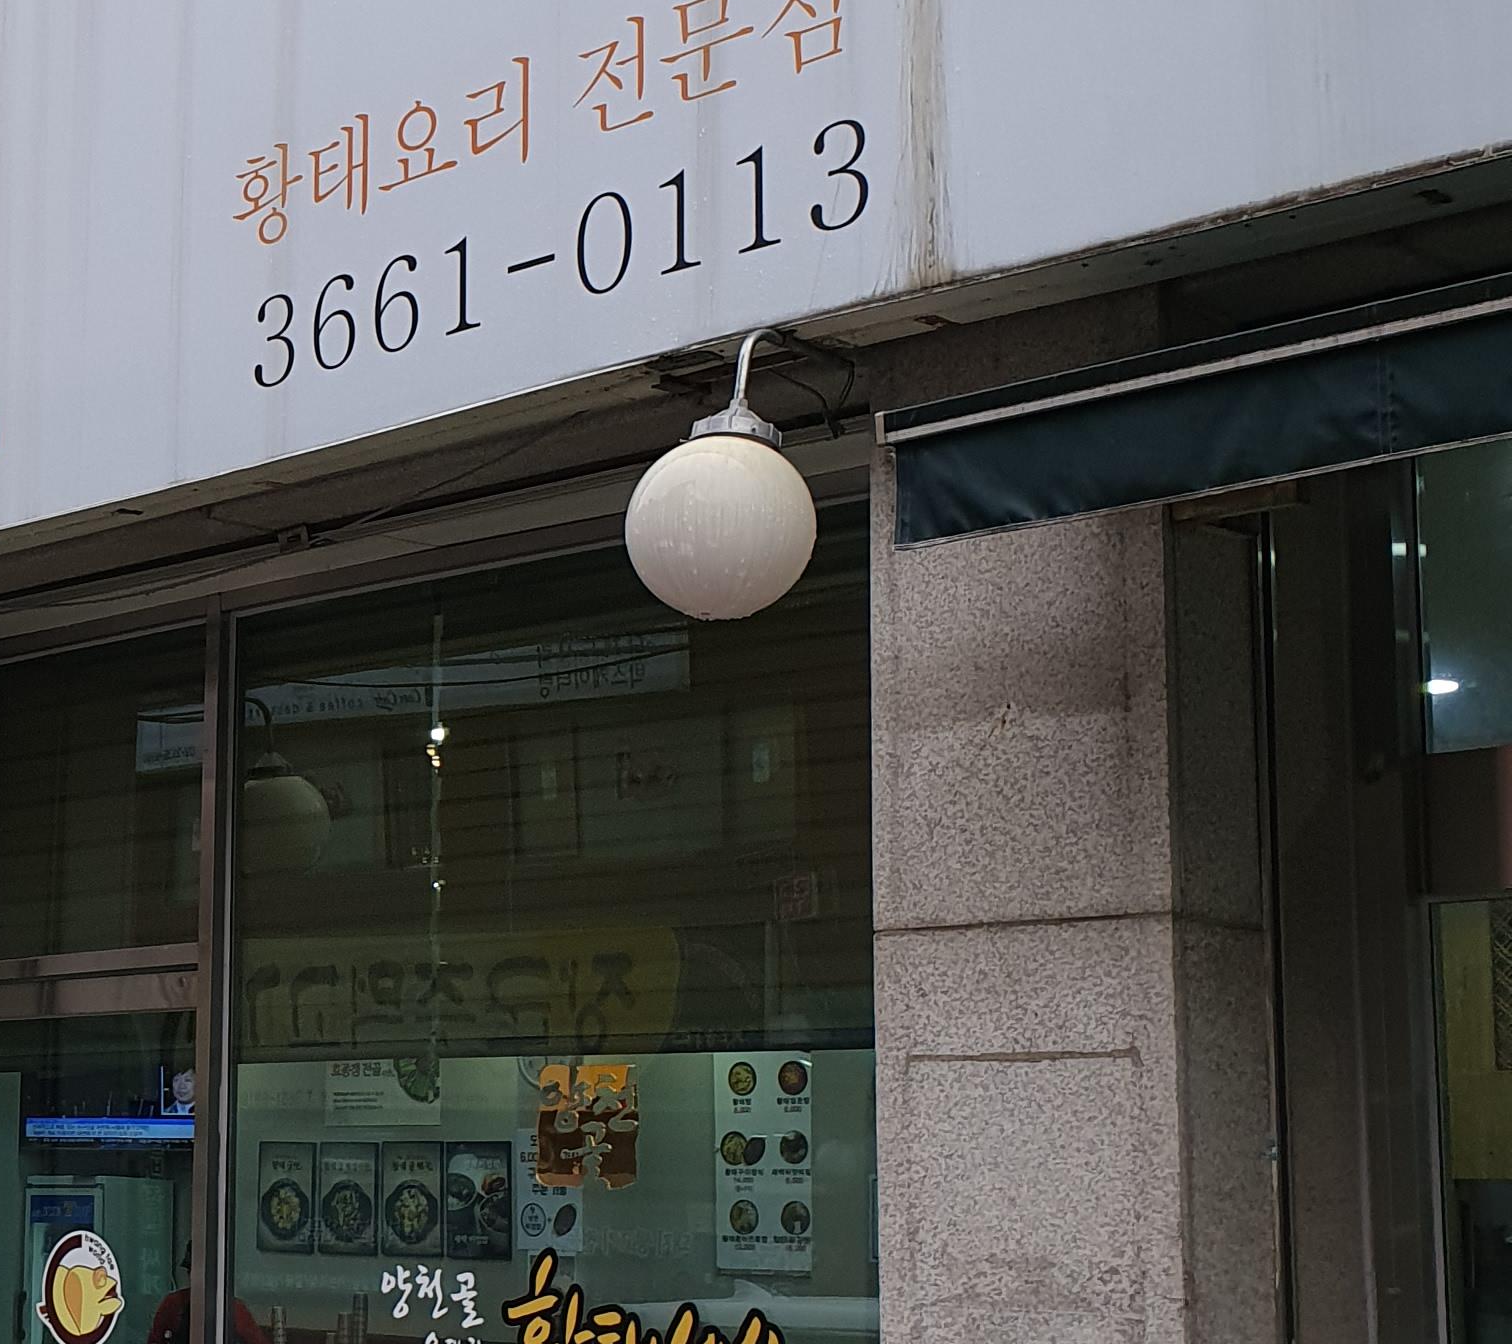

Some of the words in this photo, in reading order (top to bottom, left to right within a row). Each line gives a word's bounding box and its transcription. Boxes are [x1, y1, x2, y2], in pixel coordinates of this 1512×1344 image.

[232, 56, 532, 246] 황태요리
[253, 119, 870, 388] 3661-0113
[381, 1262, 486, 1329] 양천골
